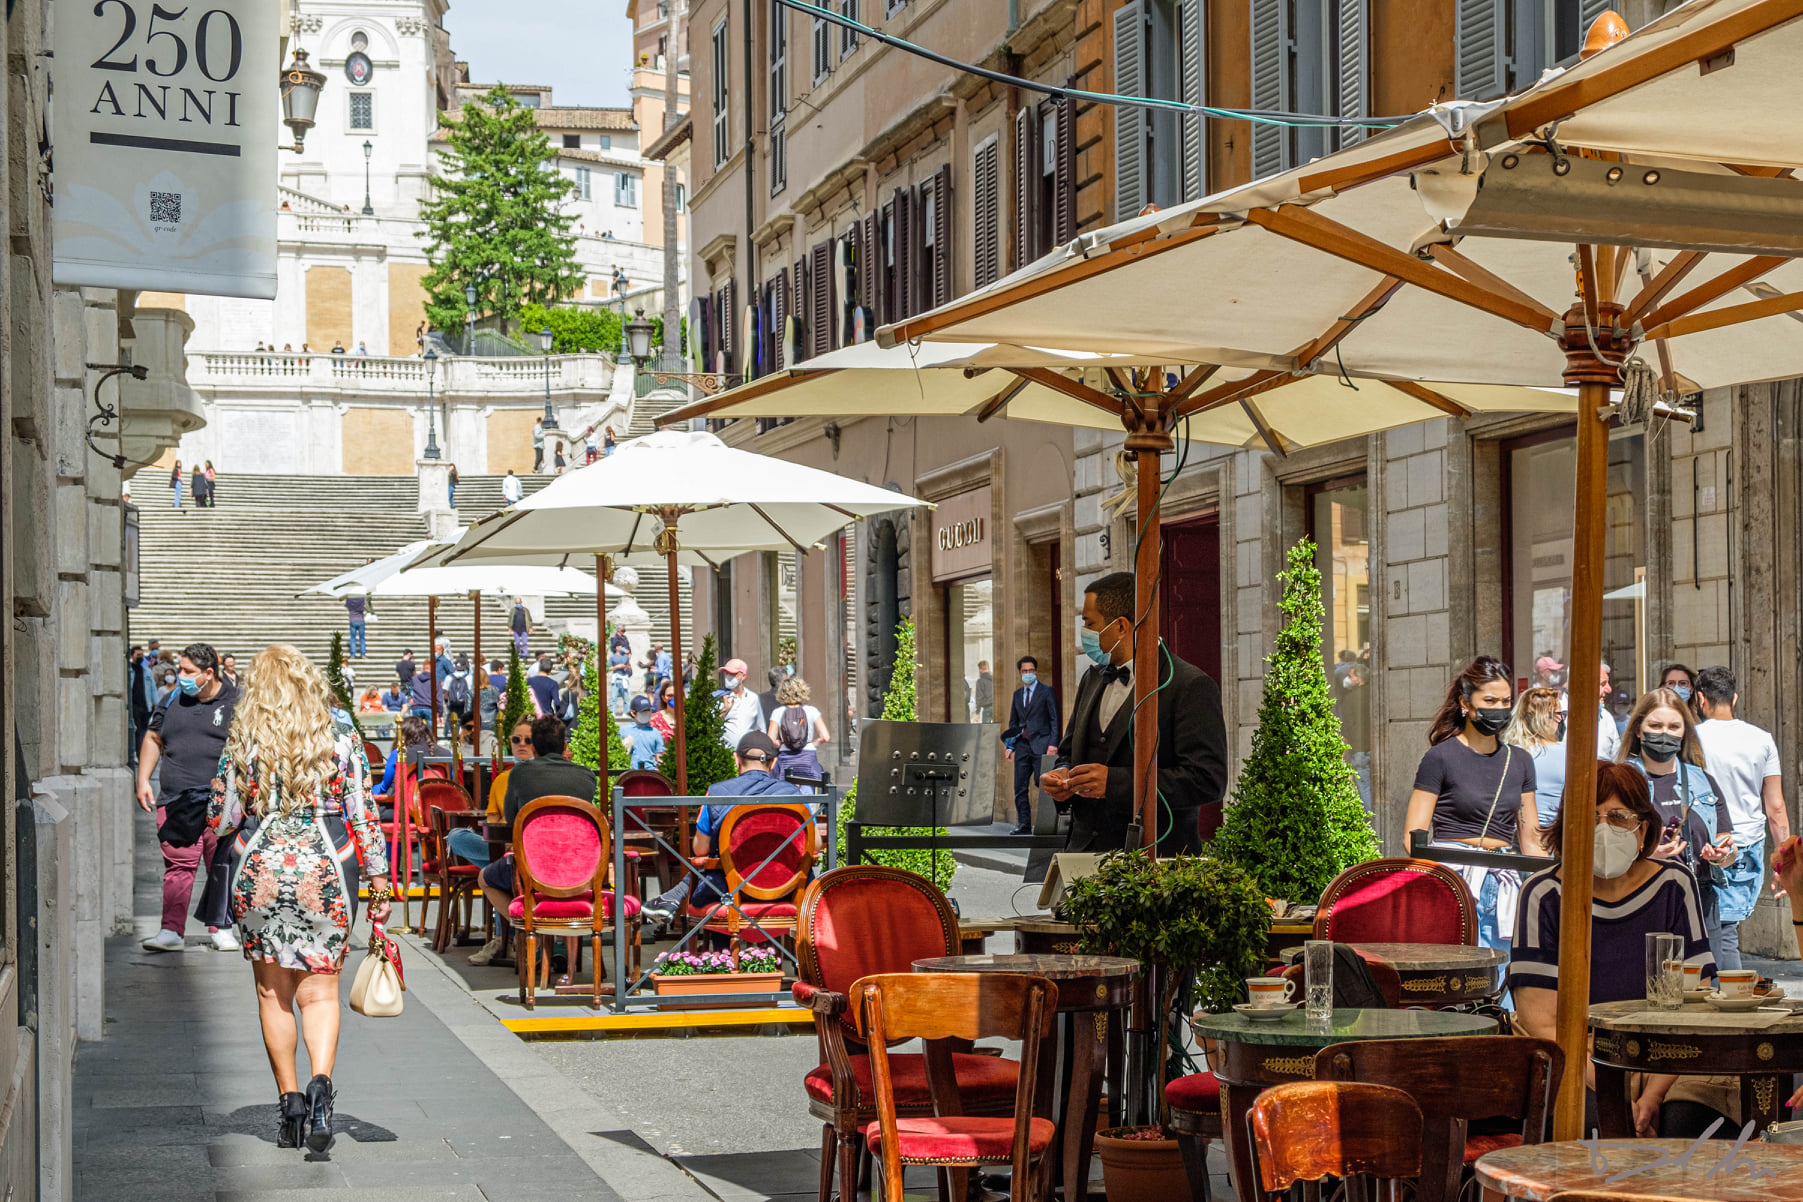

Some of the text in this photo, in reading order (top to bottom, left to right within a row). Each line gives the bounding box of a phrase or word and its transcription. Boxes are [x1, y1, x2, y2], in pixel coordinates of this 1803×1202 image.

[90, 0, 242, 82] 250
[90, 80, 241, 126] ANNI
[938, 518, 983, 550] GUCCI
